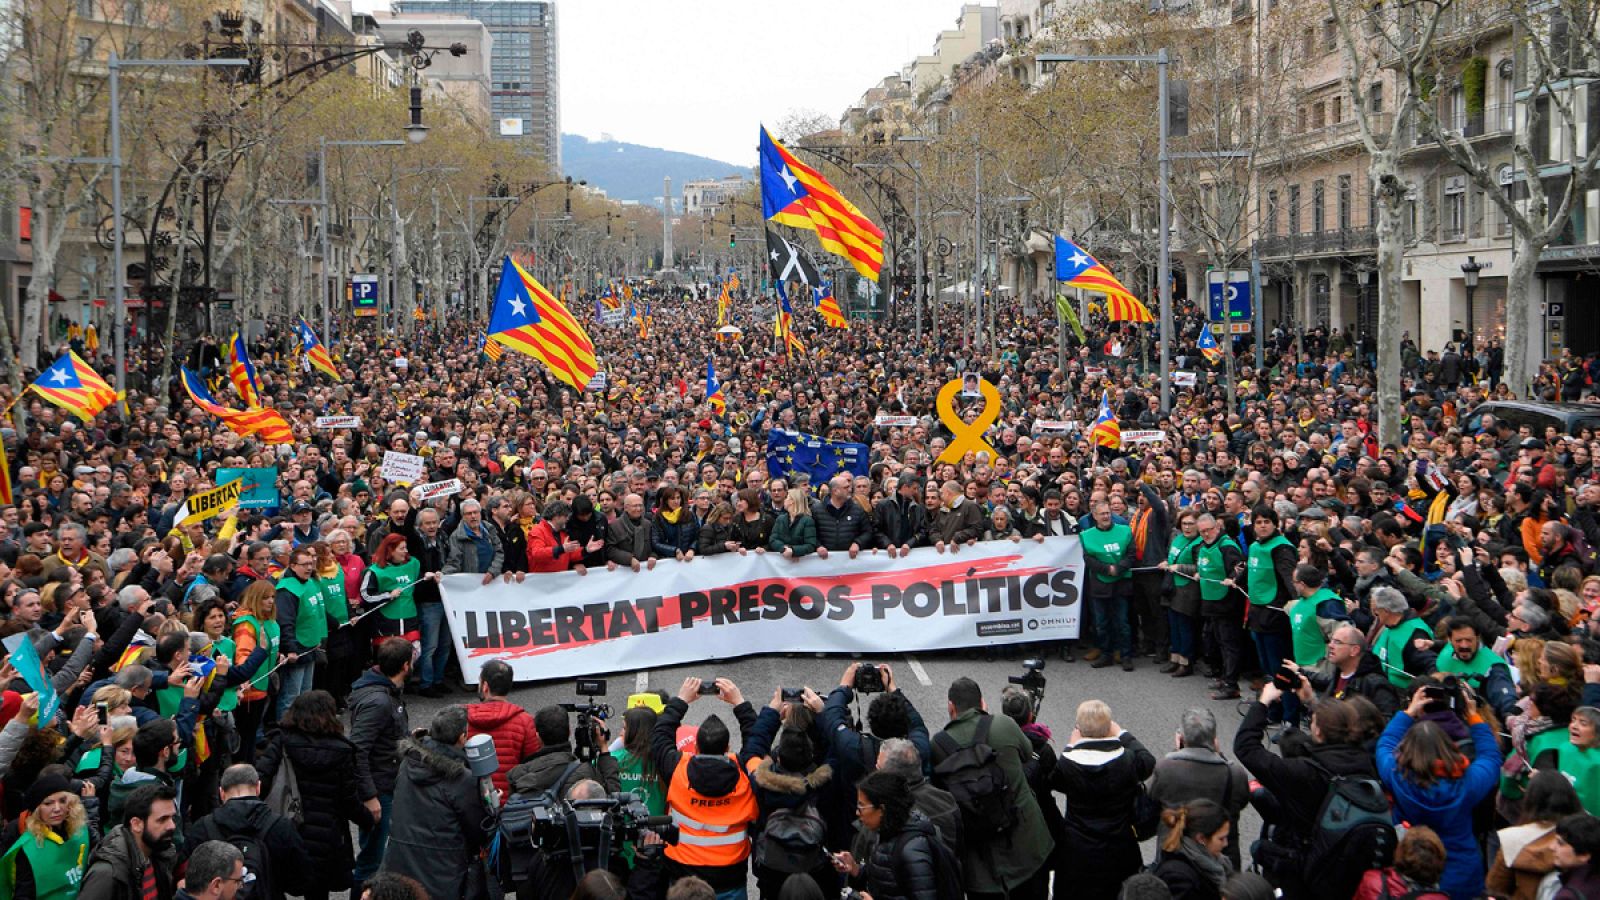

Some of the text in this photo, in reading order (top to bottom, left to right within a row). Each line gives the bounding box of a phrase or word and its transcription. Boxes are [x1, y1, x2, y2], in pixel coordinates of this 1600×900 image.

[361, 283, 372, 298] P
[1551, 304, 1561, 315] P
[187, 481, 240, 515] LIBERTAT
[454, 567, 1080, 649] LIBERTAT PRESOS POLÍTICS
[691, 798, 731, 808] PRESS
